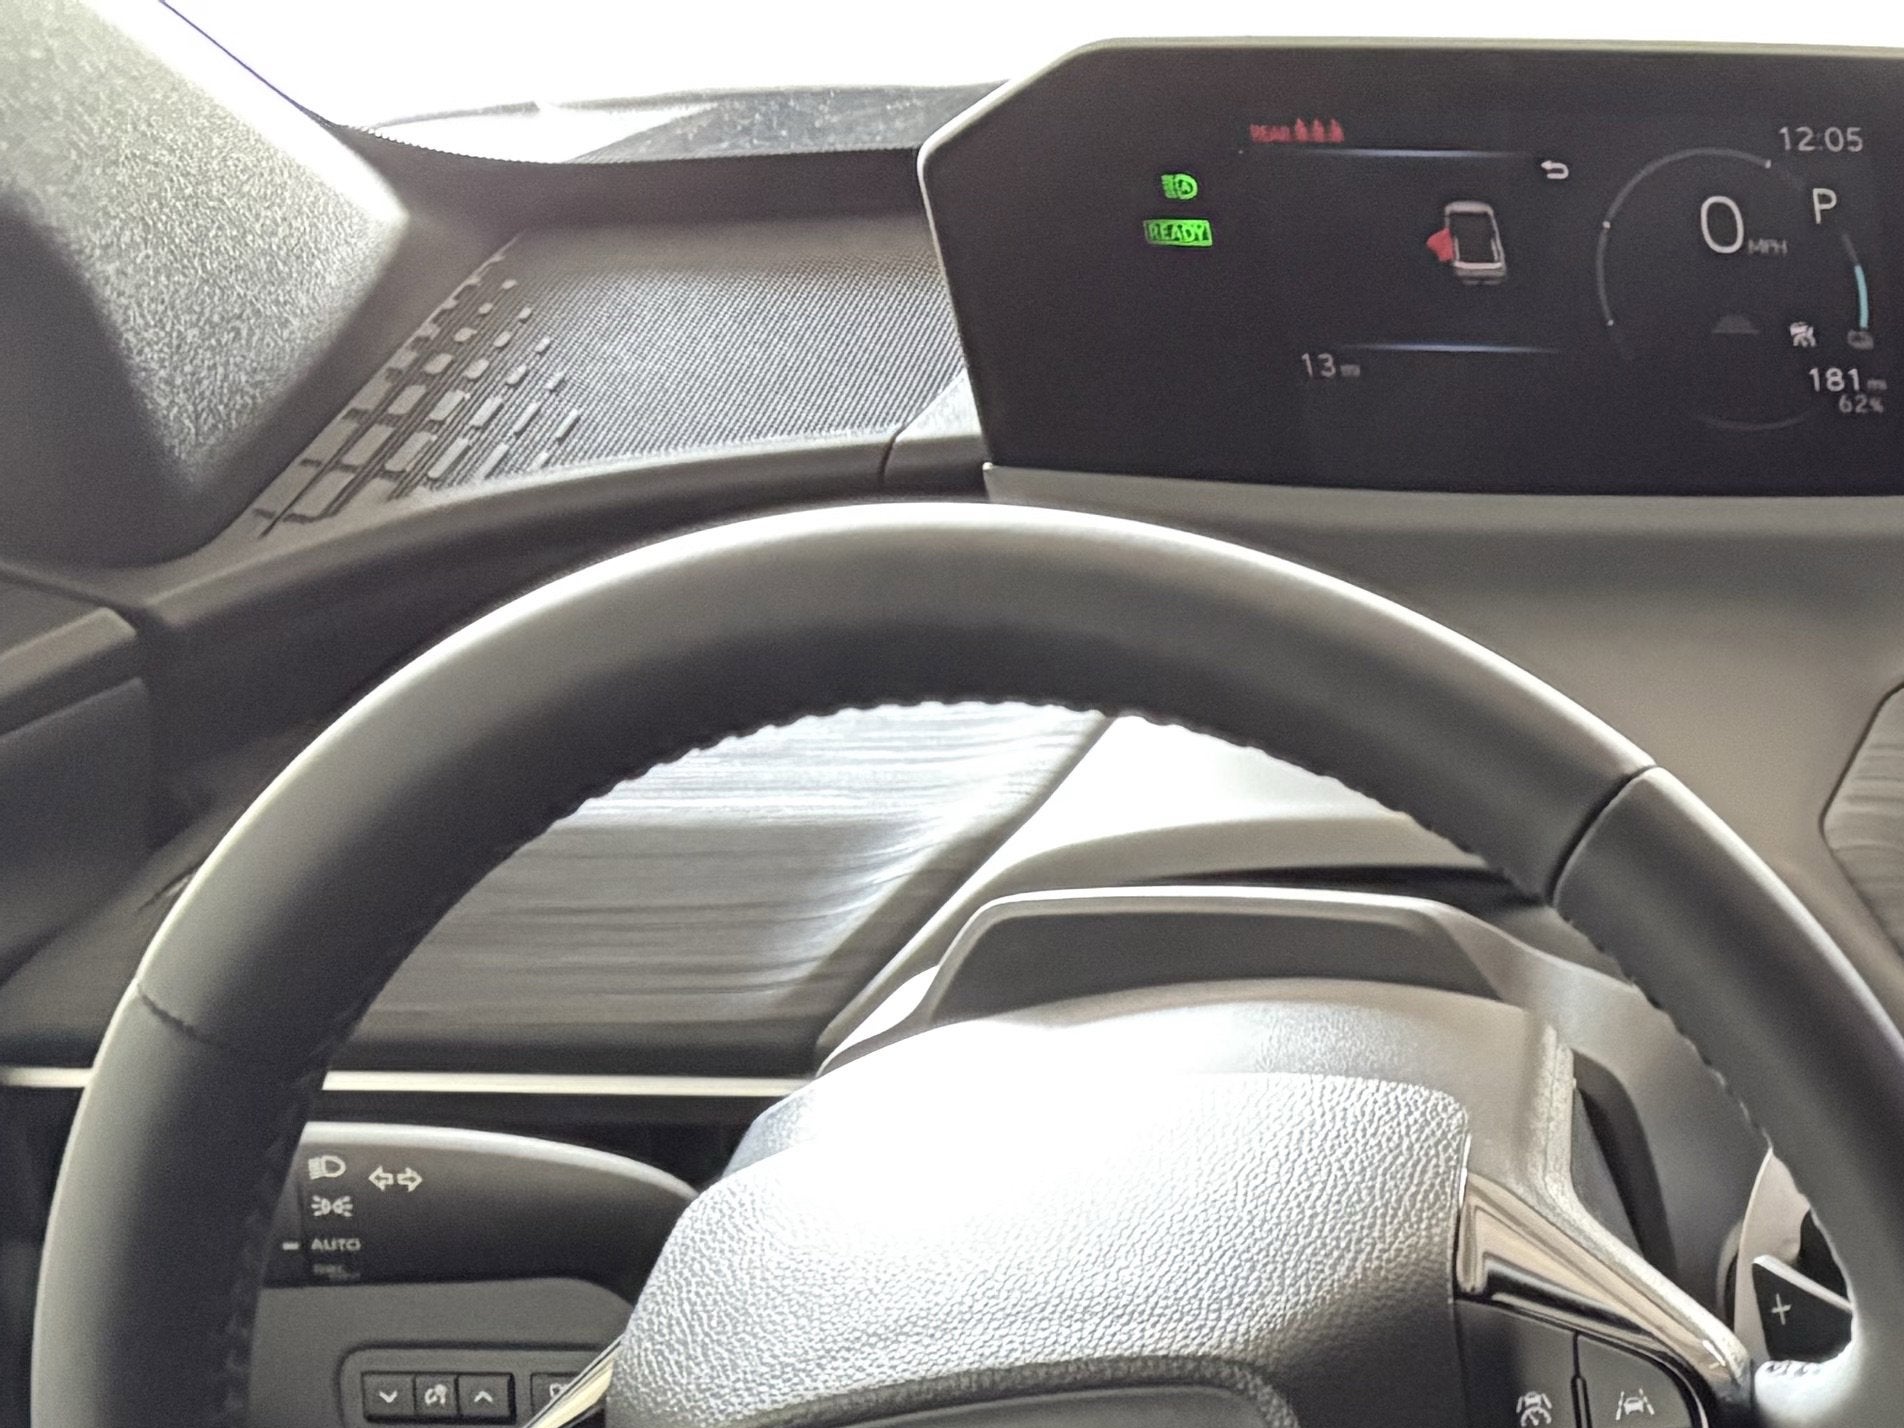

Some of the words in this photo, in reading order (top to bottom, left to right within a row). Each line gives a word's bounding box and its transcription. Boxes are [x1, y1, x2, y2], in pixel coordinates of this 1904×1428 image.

[1779, 125, 1864, 153] 12:05
[1812, 188, 1838, 224] P
[1148, 222, 1210, 244] READY
[1700, 196, 1745, 254] 0
[1302, 353, 1336, 378] 13
[1809, 367, 1860, 392] 181
[311, 1238, 361, 1252] AUTO
